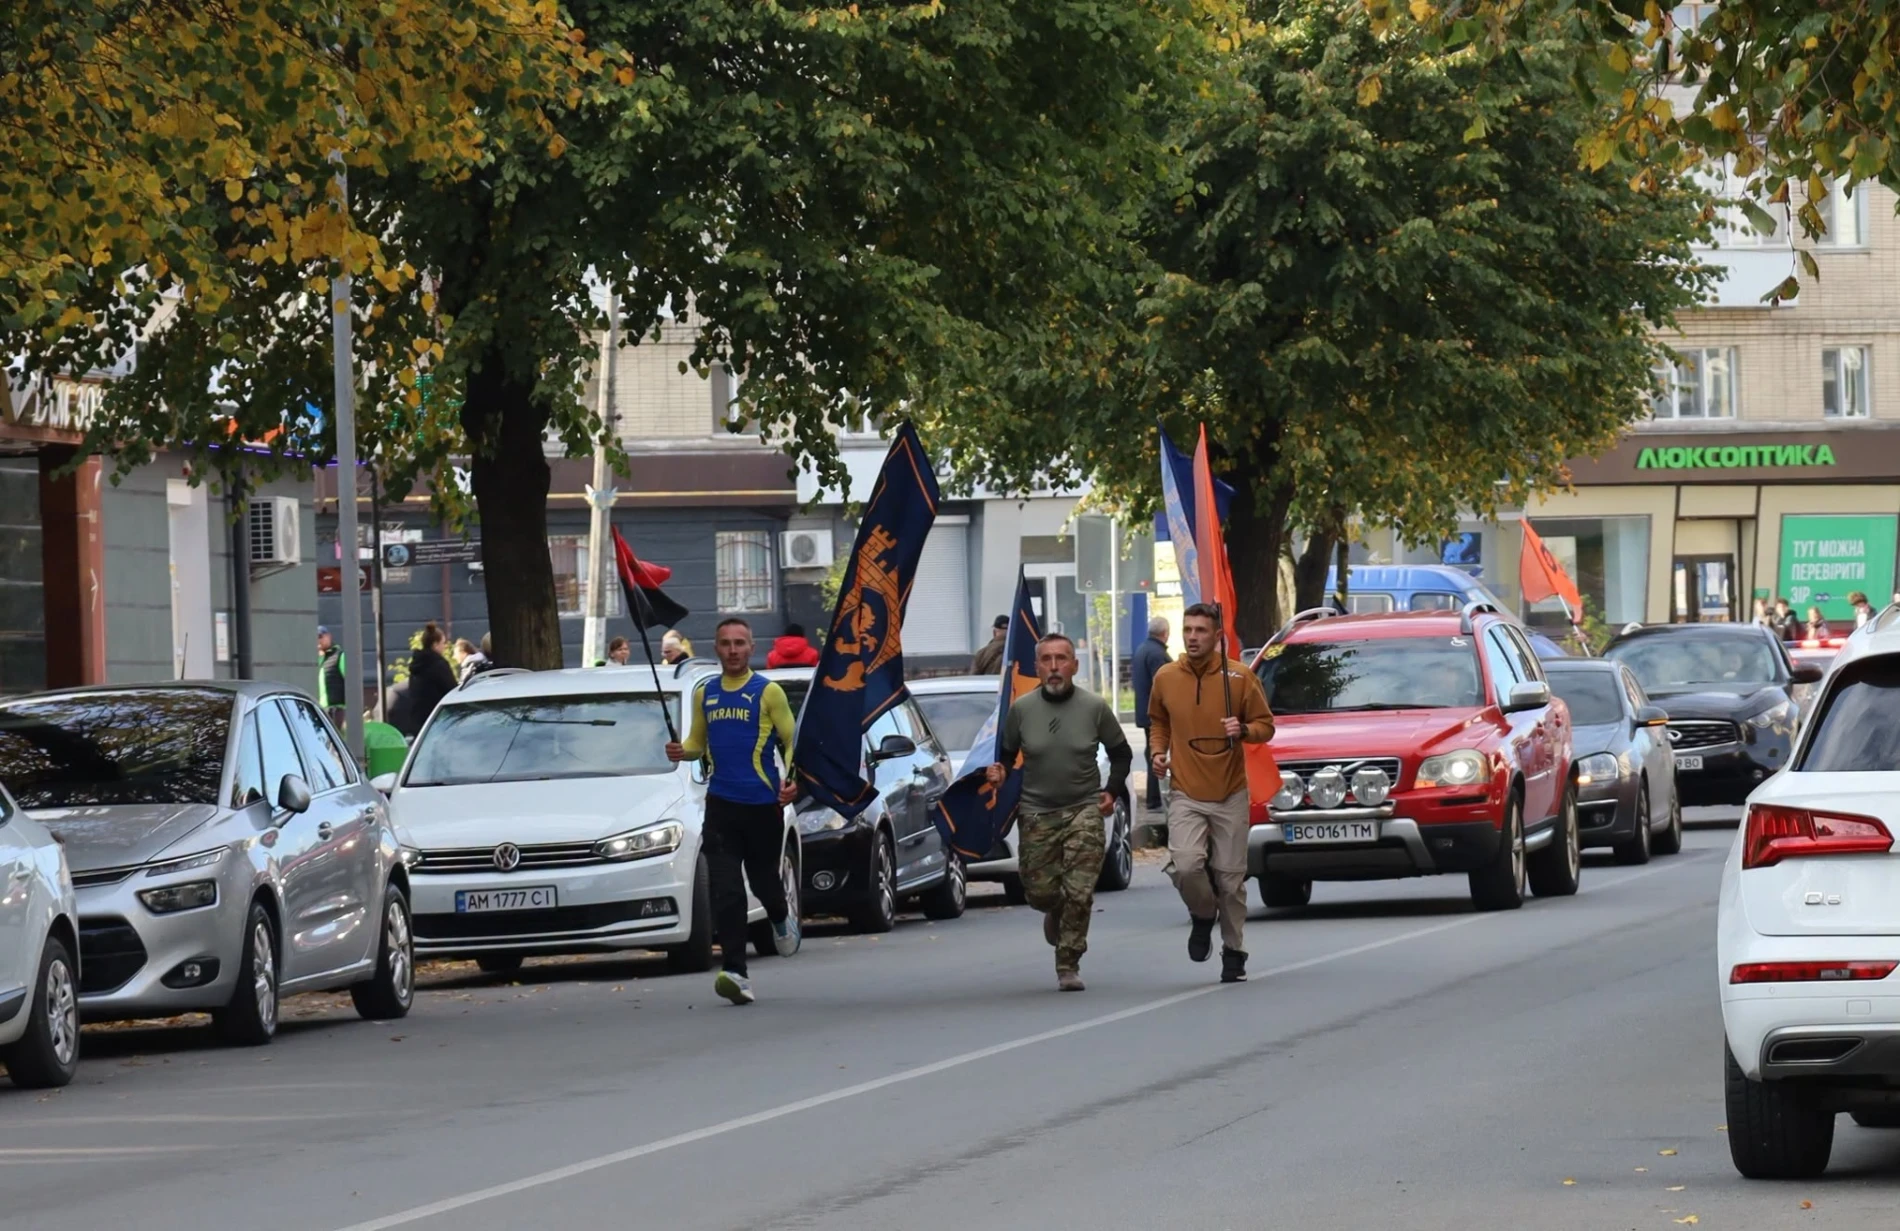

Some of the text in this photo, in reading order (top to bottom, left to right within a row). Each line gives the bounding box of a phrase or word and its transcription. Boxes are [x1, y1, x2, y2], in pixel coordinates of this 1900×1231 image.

[1636, 444, 1836, 469] ЛЮКСОПТИКА
[1792, 539, 1865, 558] ТУТ МОЖНА
[1791, 562, 1866, 580] ПЕРЕВІРИТИ
[1790, 586, 1810, 604] ЗІР
[707, 707, 750, 723] UKRAINE
[1294, 823, 1372, 840] BC 0161 TM
[468, 890, 550, 909] AM 1777 CI
